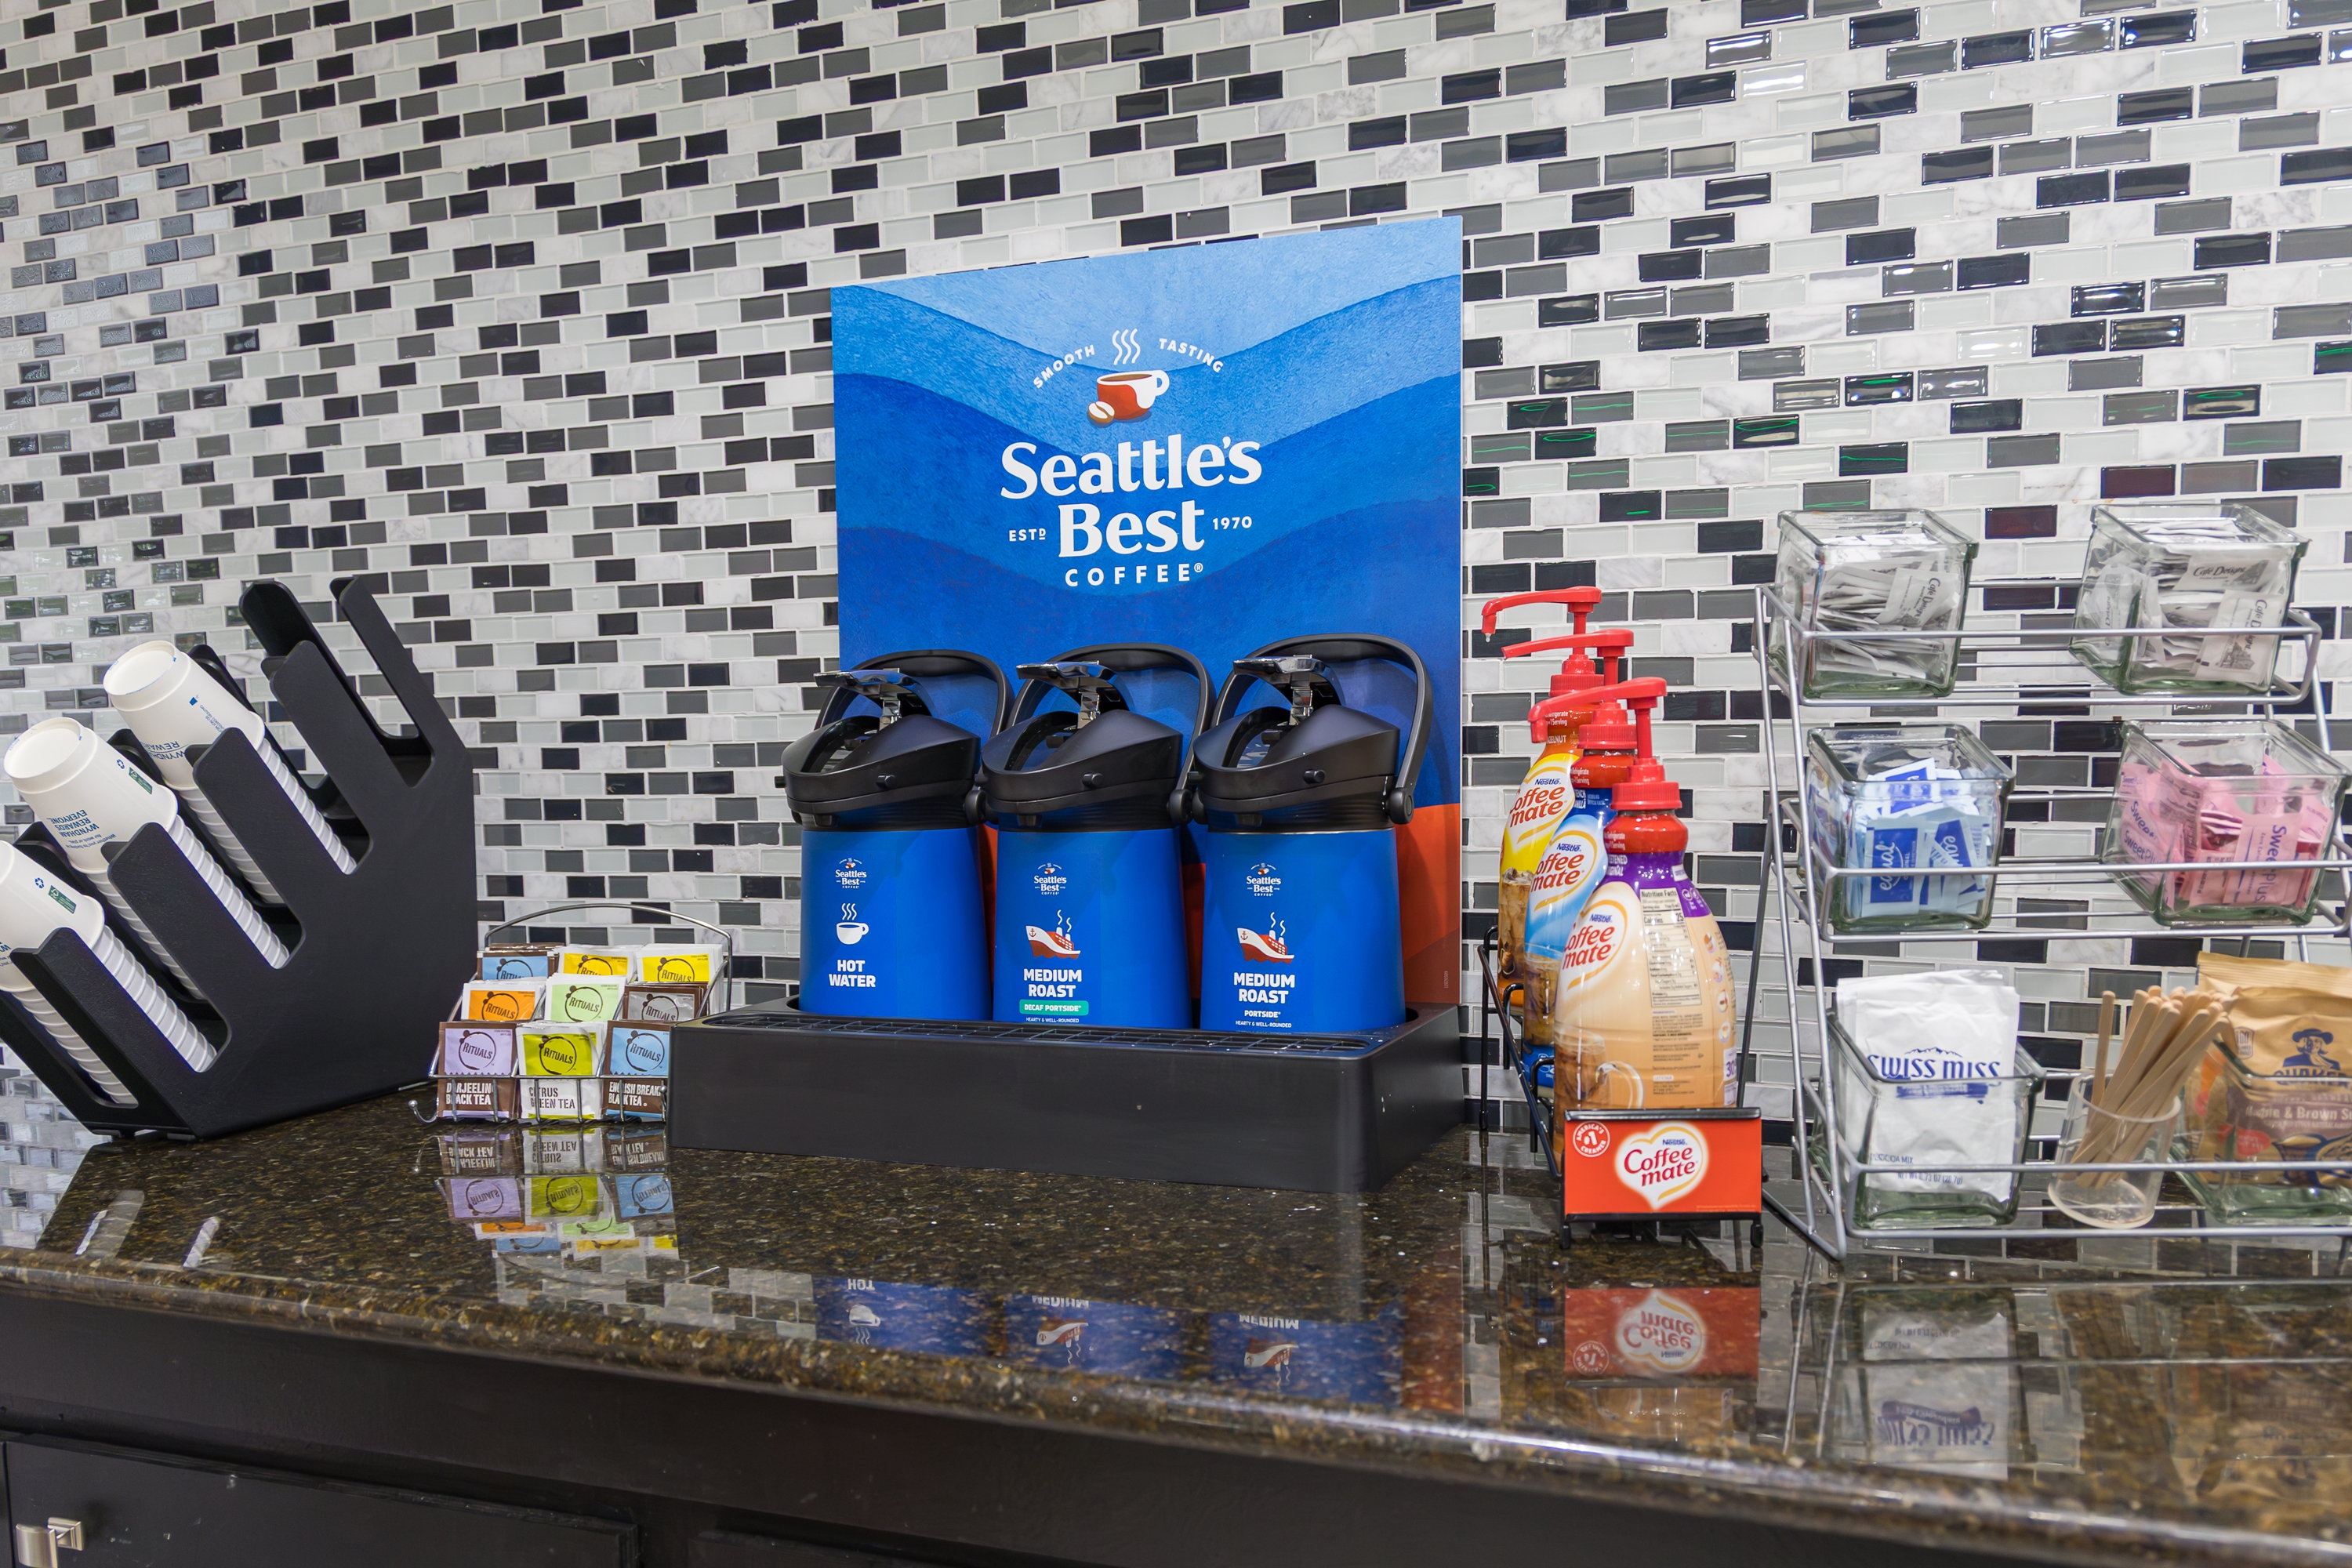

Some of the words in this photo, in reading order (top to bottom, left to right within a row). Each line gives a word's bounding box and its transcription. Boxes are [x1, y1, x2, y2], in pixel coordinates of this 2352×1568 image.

[1033, 343, 1095, 388] SMOOTH
[1159, 338, 1224, 373] TASTING
[1000, 434, 1263, 499] Seattle's
[1008, 528, 1047, 542] ESTD
[1058, 499, 1205, 557] Best
[1213, 515, 1252, 531] 1970
[2213, 565, 2247, 576] Delight
[1928, 577, 1941, 596] Café
[2253, 599, 2268, 619] Café
[1547, 735, 1567, 744] AZELNUT
[1510, 800, 1564, 828] mate
[54, 817, 93, 832] REWARDS
[59, 823, 100, 838] WYNDHAM
[1535, 852, 1584, 875] offee
[1875, 840, 1896, 891] eual
[835, 869, 867, 878] Seattle's
[1033, 875, 1067, 884] Seattle's
[1246, 875, 1282, 884] Seattle's
[1253, 884, 1273, 893] Best
[1531, 870, 1581, 893] mate
[1675, 913, 1684, 922] 25
[1563, 943, 1612, 971] mate
[837, 959, 866, 972] HOT
[662, 969, 691, 982] RITUALS
[828, 974, 877, 988] WATER
[1023, 968, 1082, 982] MEDIUM
[1233, 972, 1295, 989] MEDIUM
[1028, 984, 1076, 998] ROAST
[1238, 988, 1289, 1004] ROAST
[485, 1003, 516, 1020] RITUALS
[568, 996, 600, 1013] RITUALS
[463, 1041, 493, 1060] RITUALS
[543, 1047, 573, 1065] RITUALS
[630, 1043, 661, 1062] RITUALS
[445, 1083, 494, 1094] DRJEELIN
[445, 1094, 473, 1105] BACK
[473, 1094, 492, 1105] TEA
[530, 1098, 556, 1109] GEEN
[557, 1098, 575, 1109] TEA
[608, 1092, 628, 1105] BLAK
[629, 1095, 642, 1106] TEA
[2284, 1106, 2293, 1119] &
[2296, 1106, 2337, 1120] Brown
[1576, 1123, 1605, 1142] AMERICA'S
[1584, 1131, 1598, 1145] #1
[1580, 1140, 1607, 1154] CREAMER
[1624, 1147, 1693, 1174] Coffee
[1642, 1160, 1697, 1187] mate
